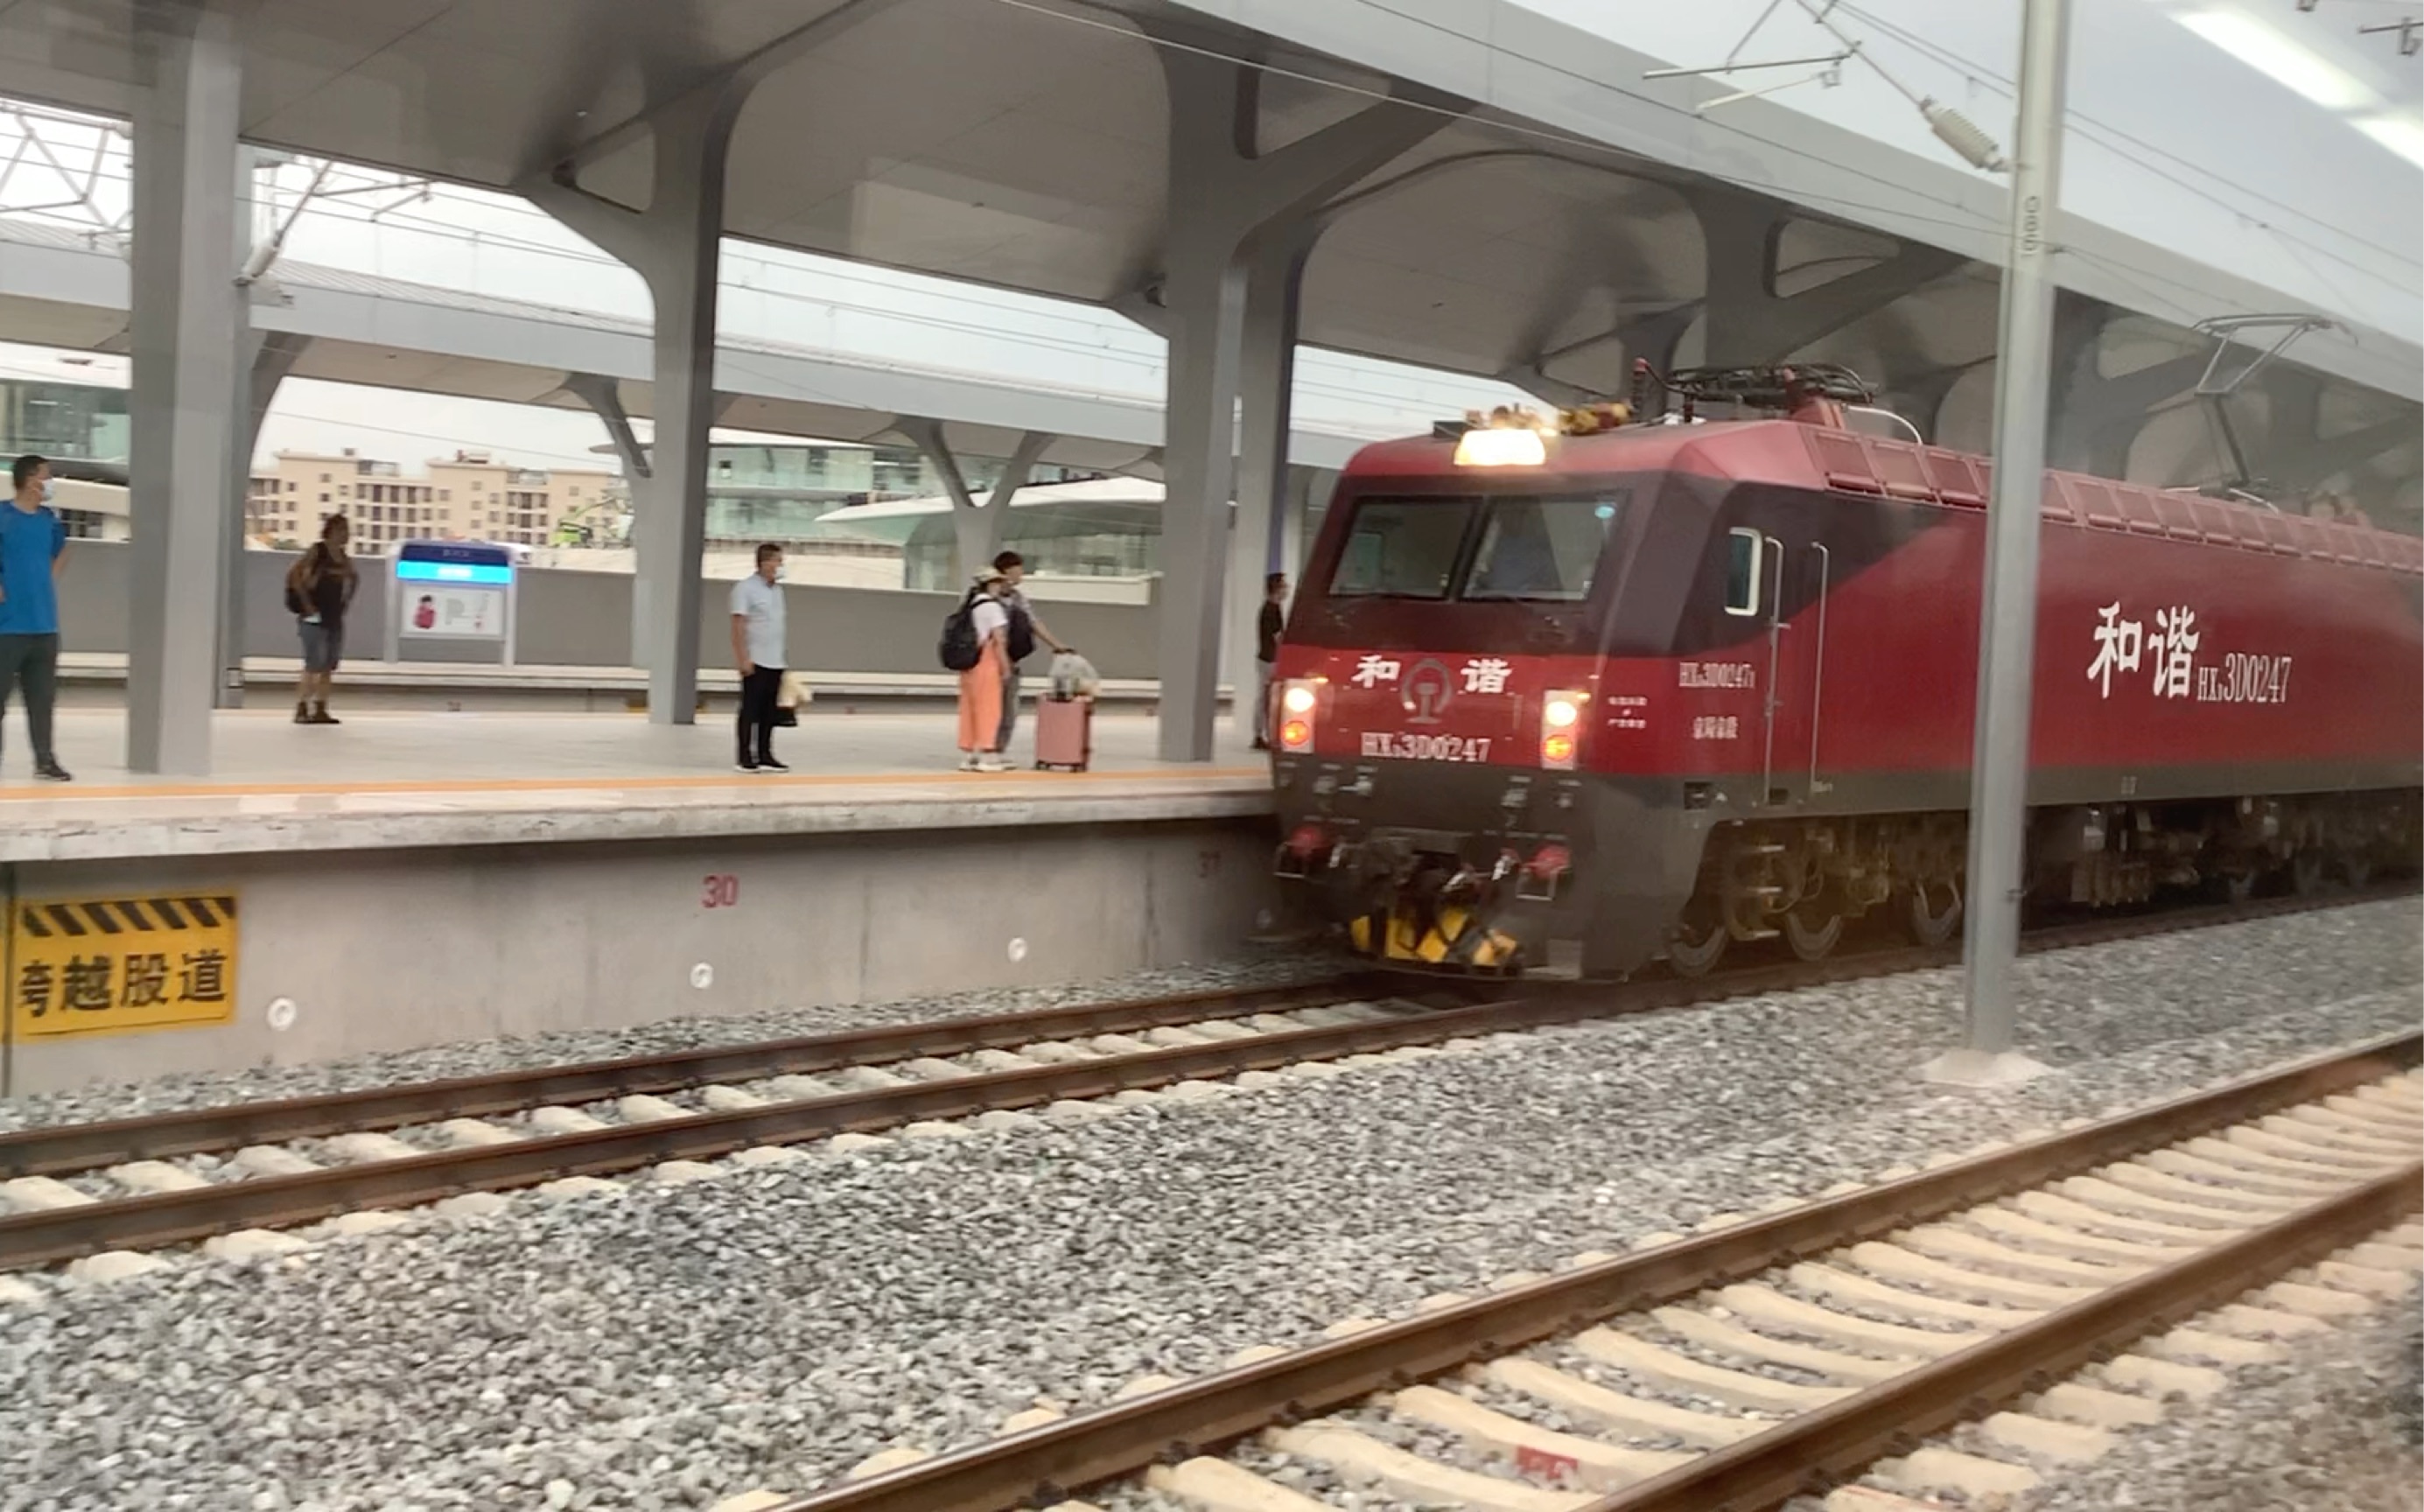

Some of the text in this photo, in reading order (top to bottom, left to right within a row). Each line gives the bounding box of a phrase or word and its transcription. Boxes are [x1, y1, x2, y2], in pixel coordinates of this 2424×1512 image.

[2087, 601, 2200, 699] 和谐
[1351, 655, 1513, 693] 和 谐
[703, 875, 739, 907] 30
